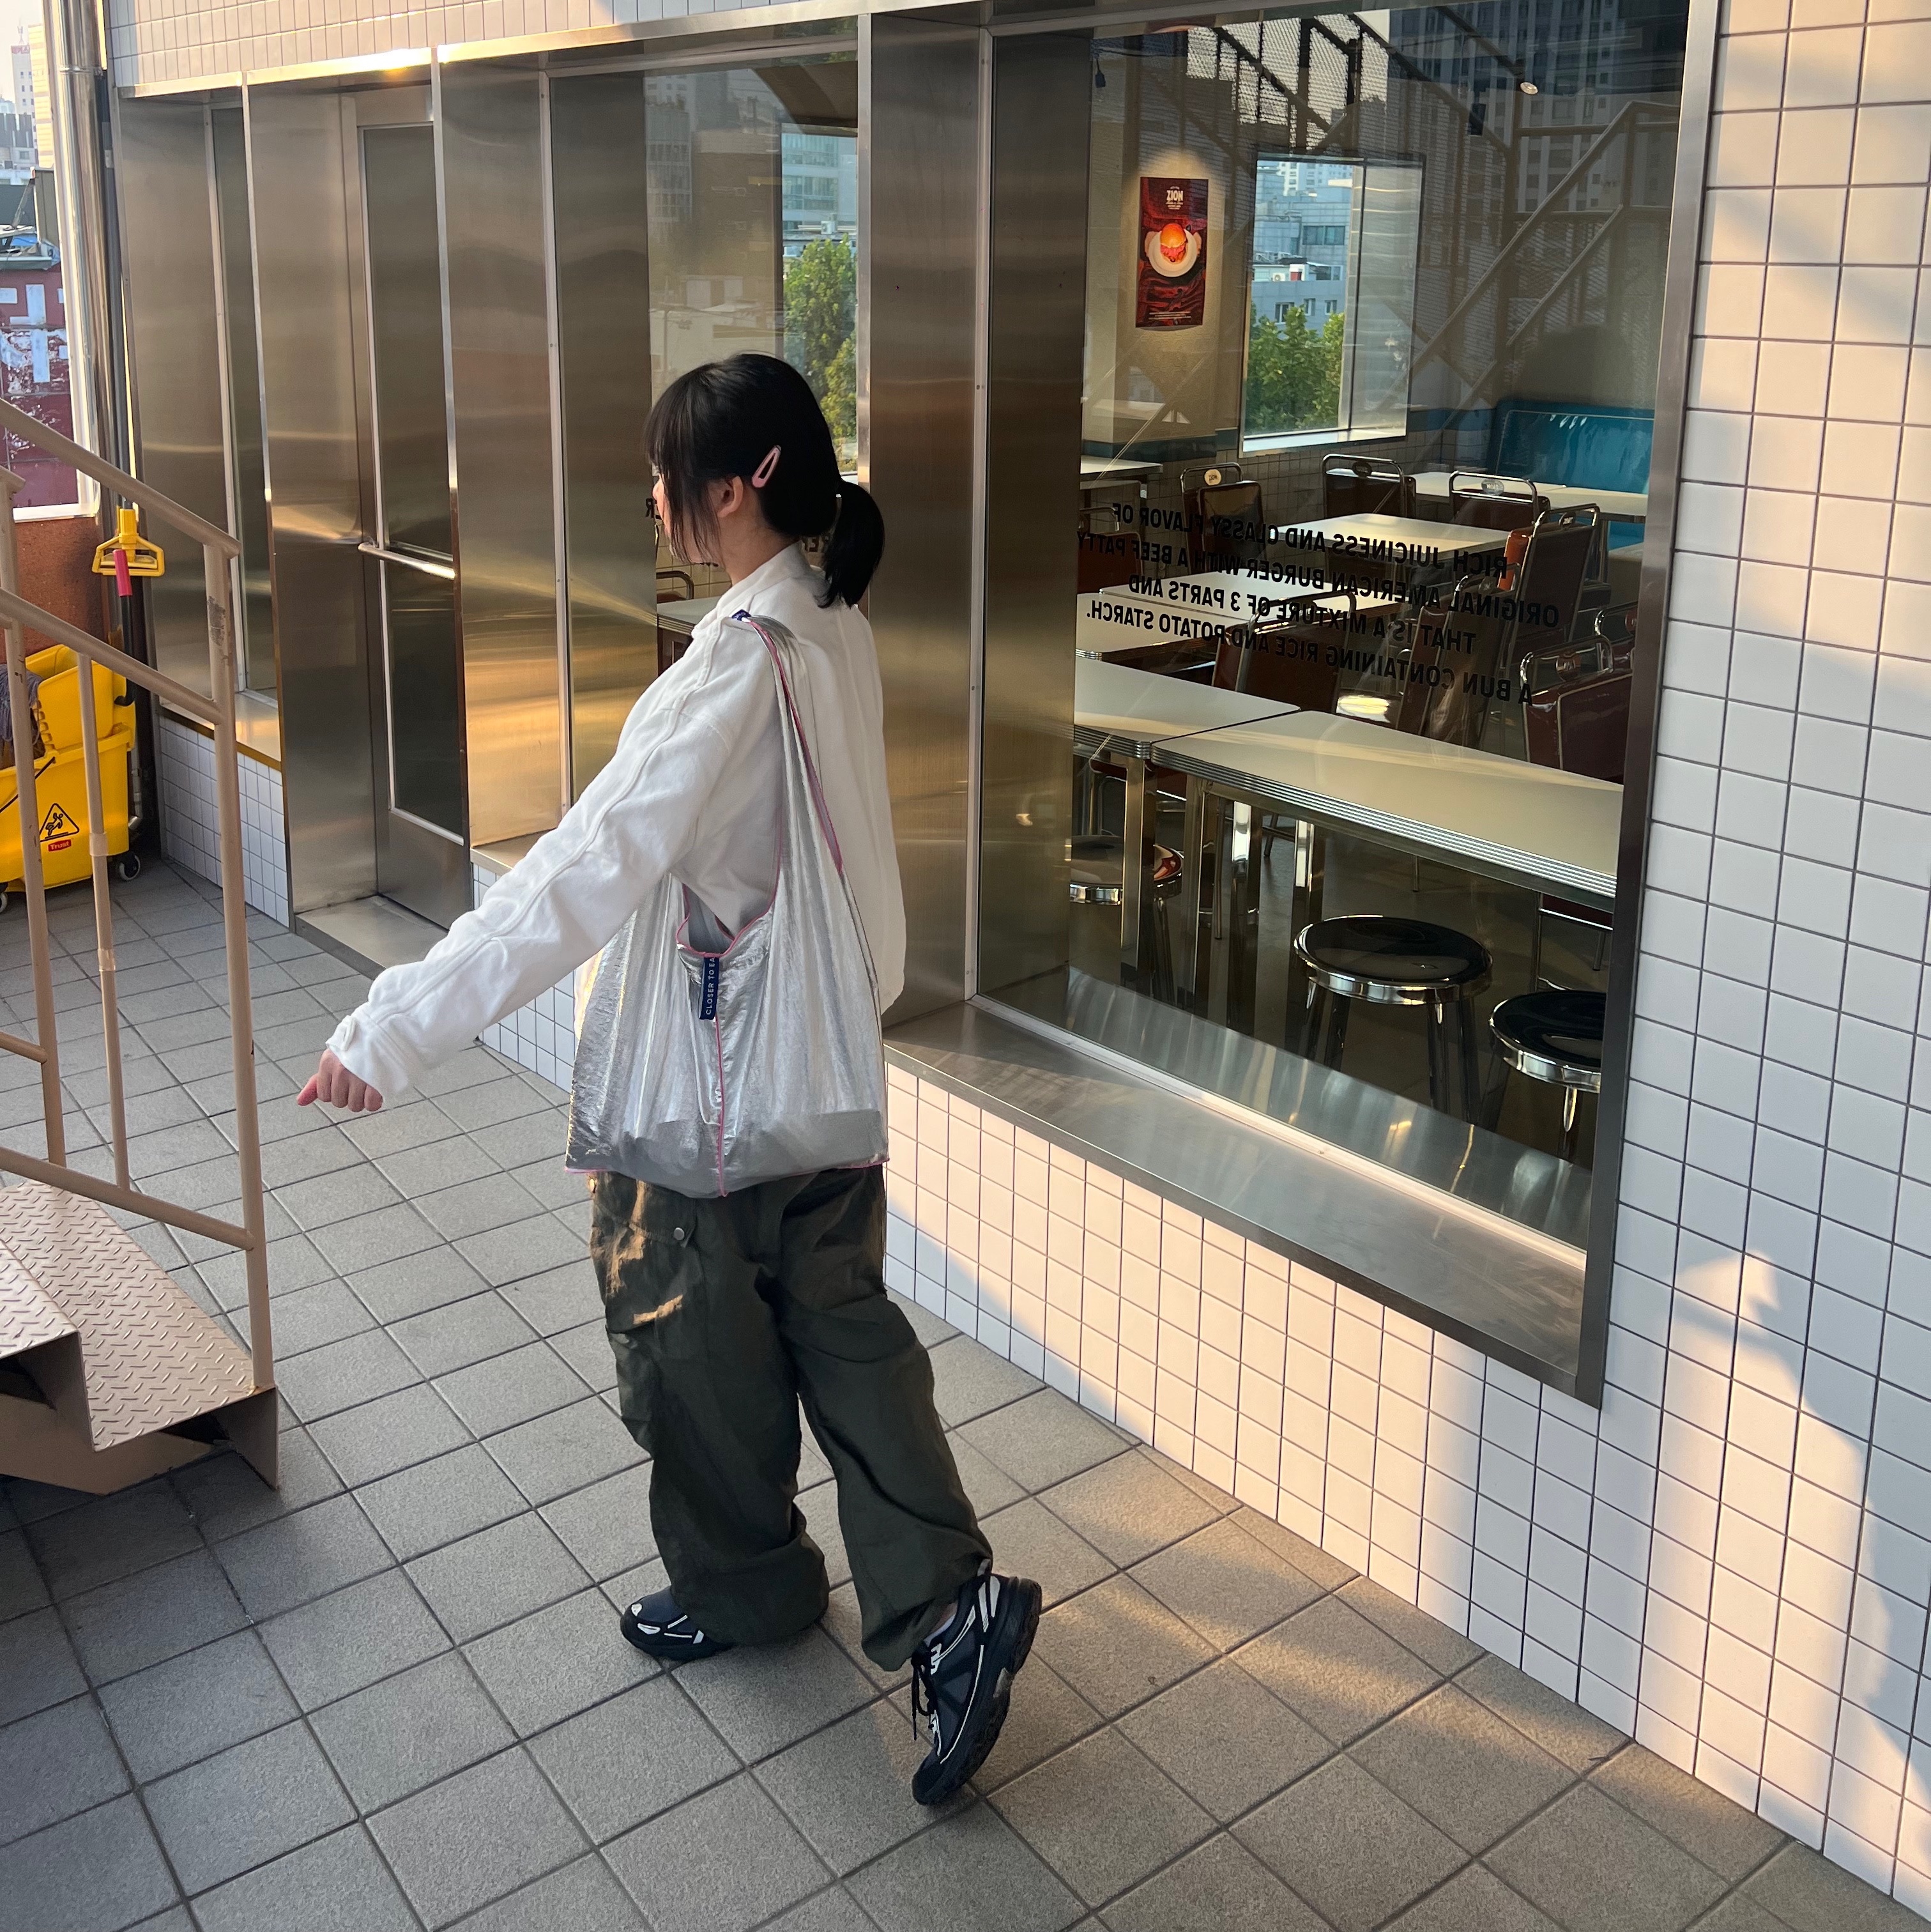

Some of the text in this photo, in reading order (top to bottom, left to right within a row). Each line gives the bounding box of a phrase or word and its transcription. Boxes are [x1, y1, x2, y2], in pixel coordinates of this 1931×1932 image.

[1166, 190, 1184, 201] ZION
[50, 841, 69, 850] Trust
[708, 969, 715, 980] TO
[705, 983, 714, 1015] CLOSER
